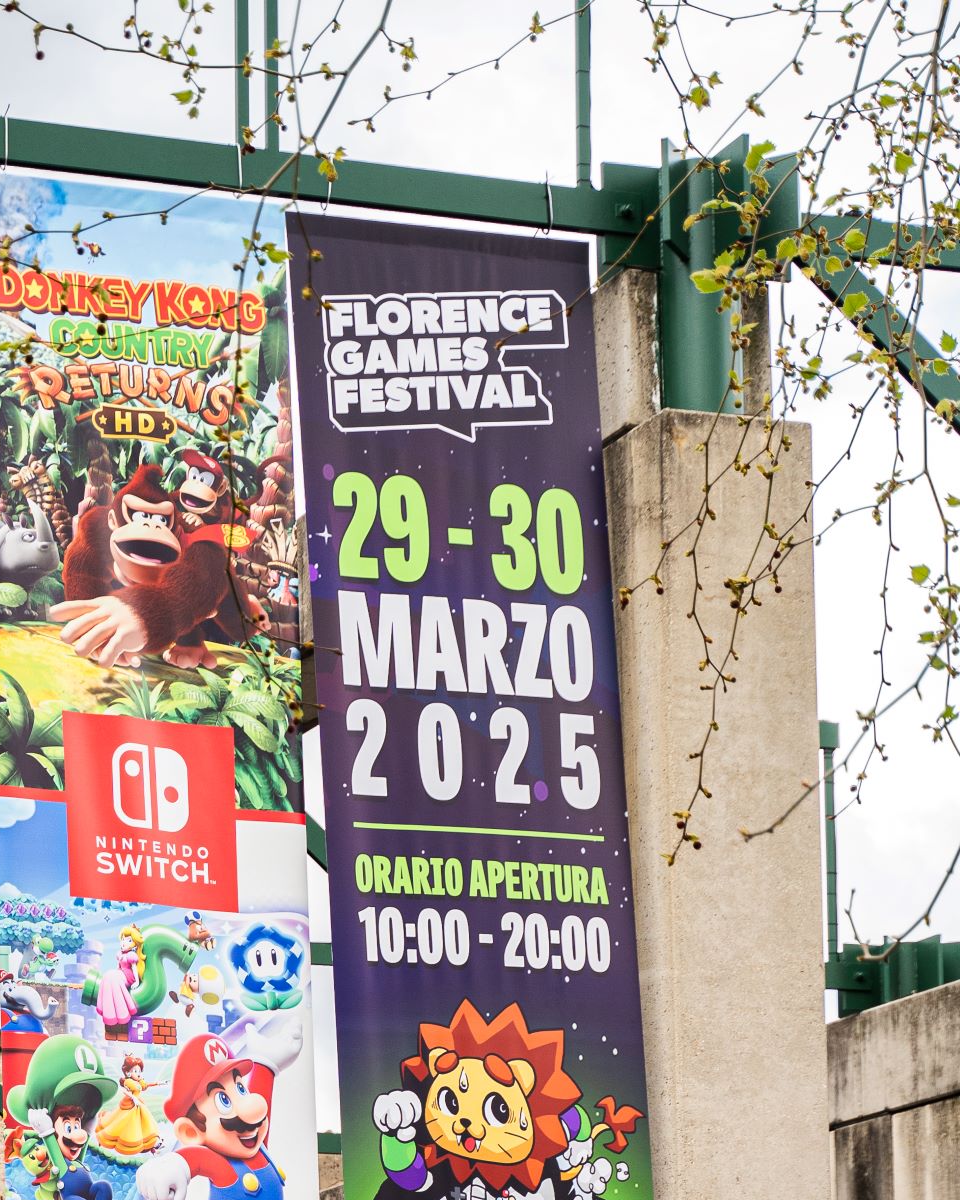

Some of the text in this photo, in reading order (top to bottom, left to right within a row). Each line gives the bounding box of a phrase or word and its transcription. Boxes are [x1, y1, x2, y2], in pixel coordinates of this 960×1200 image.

[153, 279, 266, 334] KONG
[328, 297, 553, 337] FLORENCE
[48, 317, 215, 369] COUNTRY
[331, 337, 489, 376] GAMES
[28, 362, 235, 427] RETURNS
[334, 373, 537, 414] FESTIVAL
[114, 411, 156, 434] HD
[332, 471, 430, 583] 29
[489, 483, 585, 595] 30
[337, 590, 594, 702] MARZO
[95, 835, 209, 860] NINTENDO
[95, 851, 209, 884] SWITCH
[355, 853, 610, 905] ORARIO APERTURA
[358, 906, 470, 966] 10:00
[501, 911, 611, 973] 20:00
[81, 1048, 95, 1071] L
[208, 1041, 227, 1063] M
